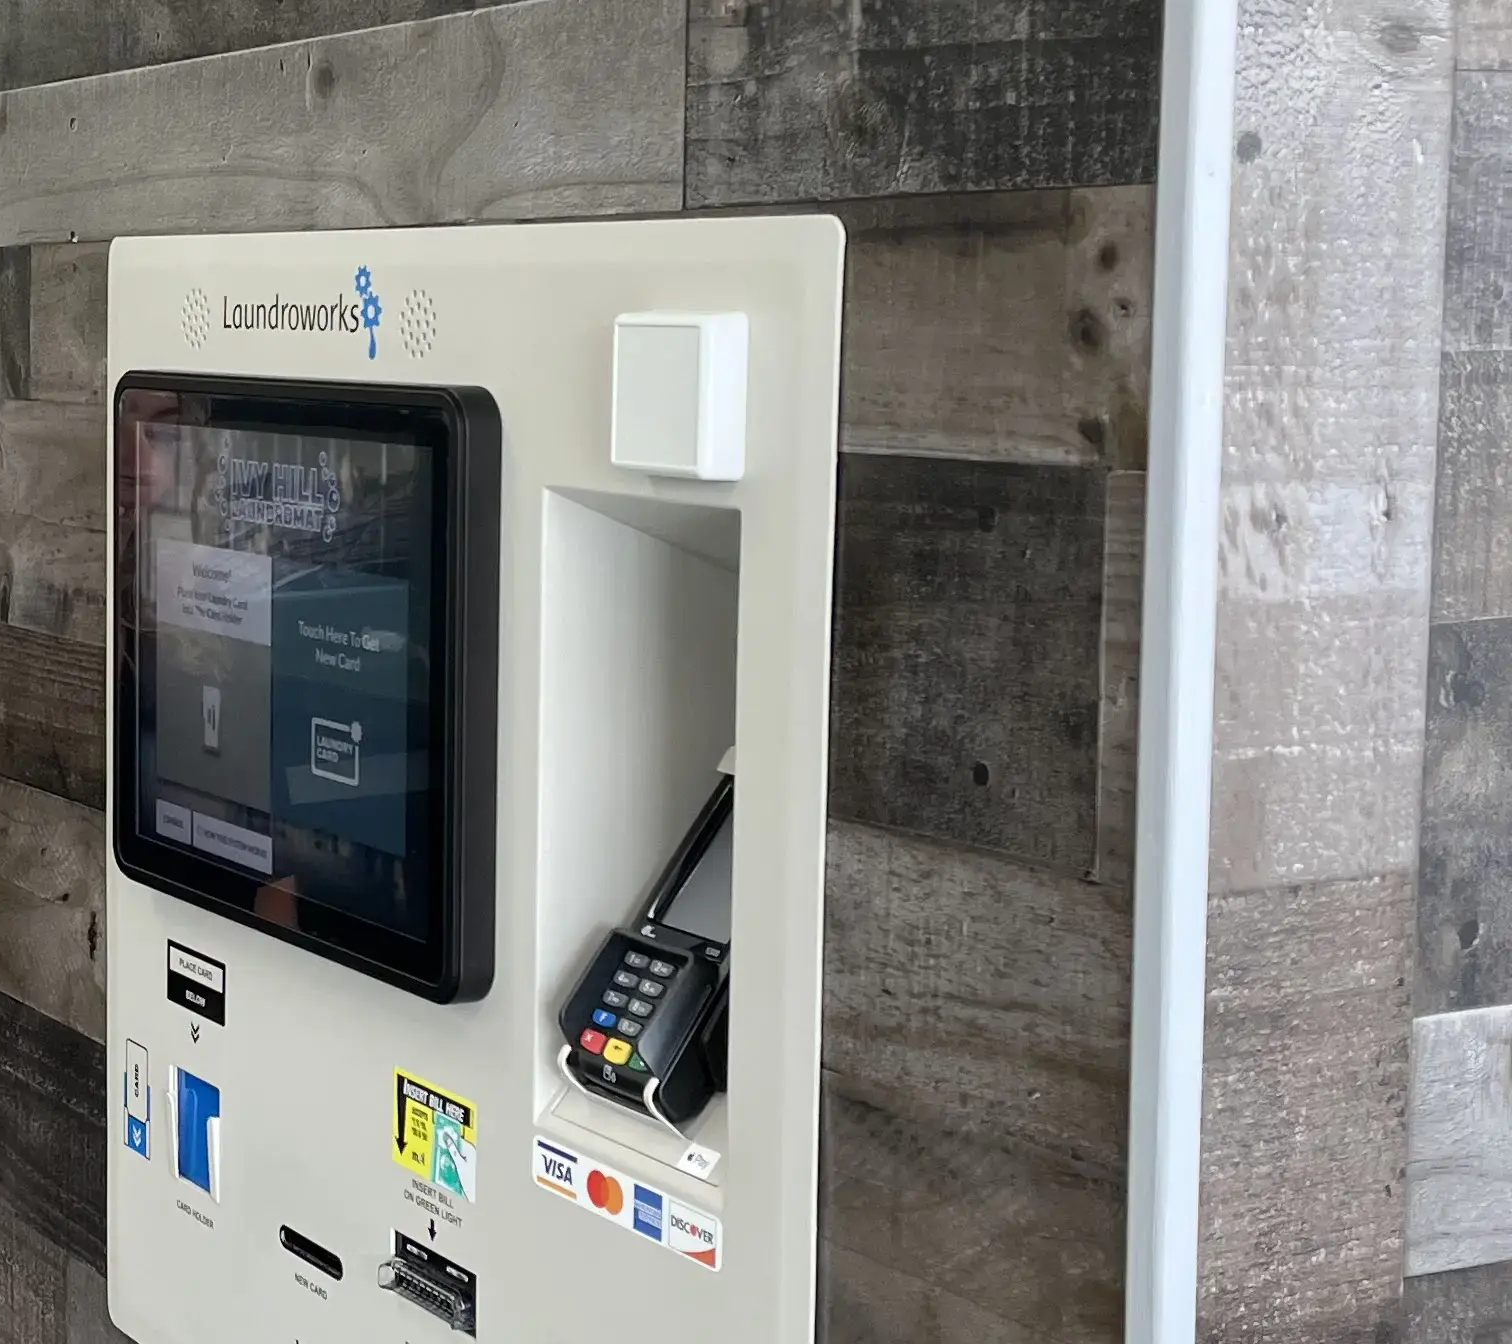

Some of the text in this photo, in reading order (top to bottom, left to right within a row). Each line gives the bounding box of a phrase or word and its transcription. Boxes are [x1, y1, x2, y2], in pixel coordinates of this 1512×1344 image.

[223, 293, 361, 334] Laundroworks
[230, 458, 324, 507] IVY HILL
[230, 497, 324, 533] LAUNDROMAT
[297, 619, 324, 640] Touch
[325, 624, 348, 646] Here
[349, 630, 361, 648] To
[314, 647, 361, 672] New Card
[179, 956, 196, 974] PLACE
[542, 1153, 573, 1185] VISA
[404, 1189, 463, 1228] ON GREEN LIGHT
[412, 1178, 455, 1210] INSERT BILL
[670, 1214, 714, 1245] DISCOVER
[309, 1281, 328, 1301] CARD
